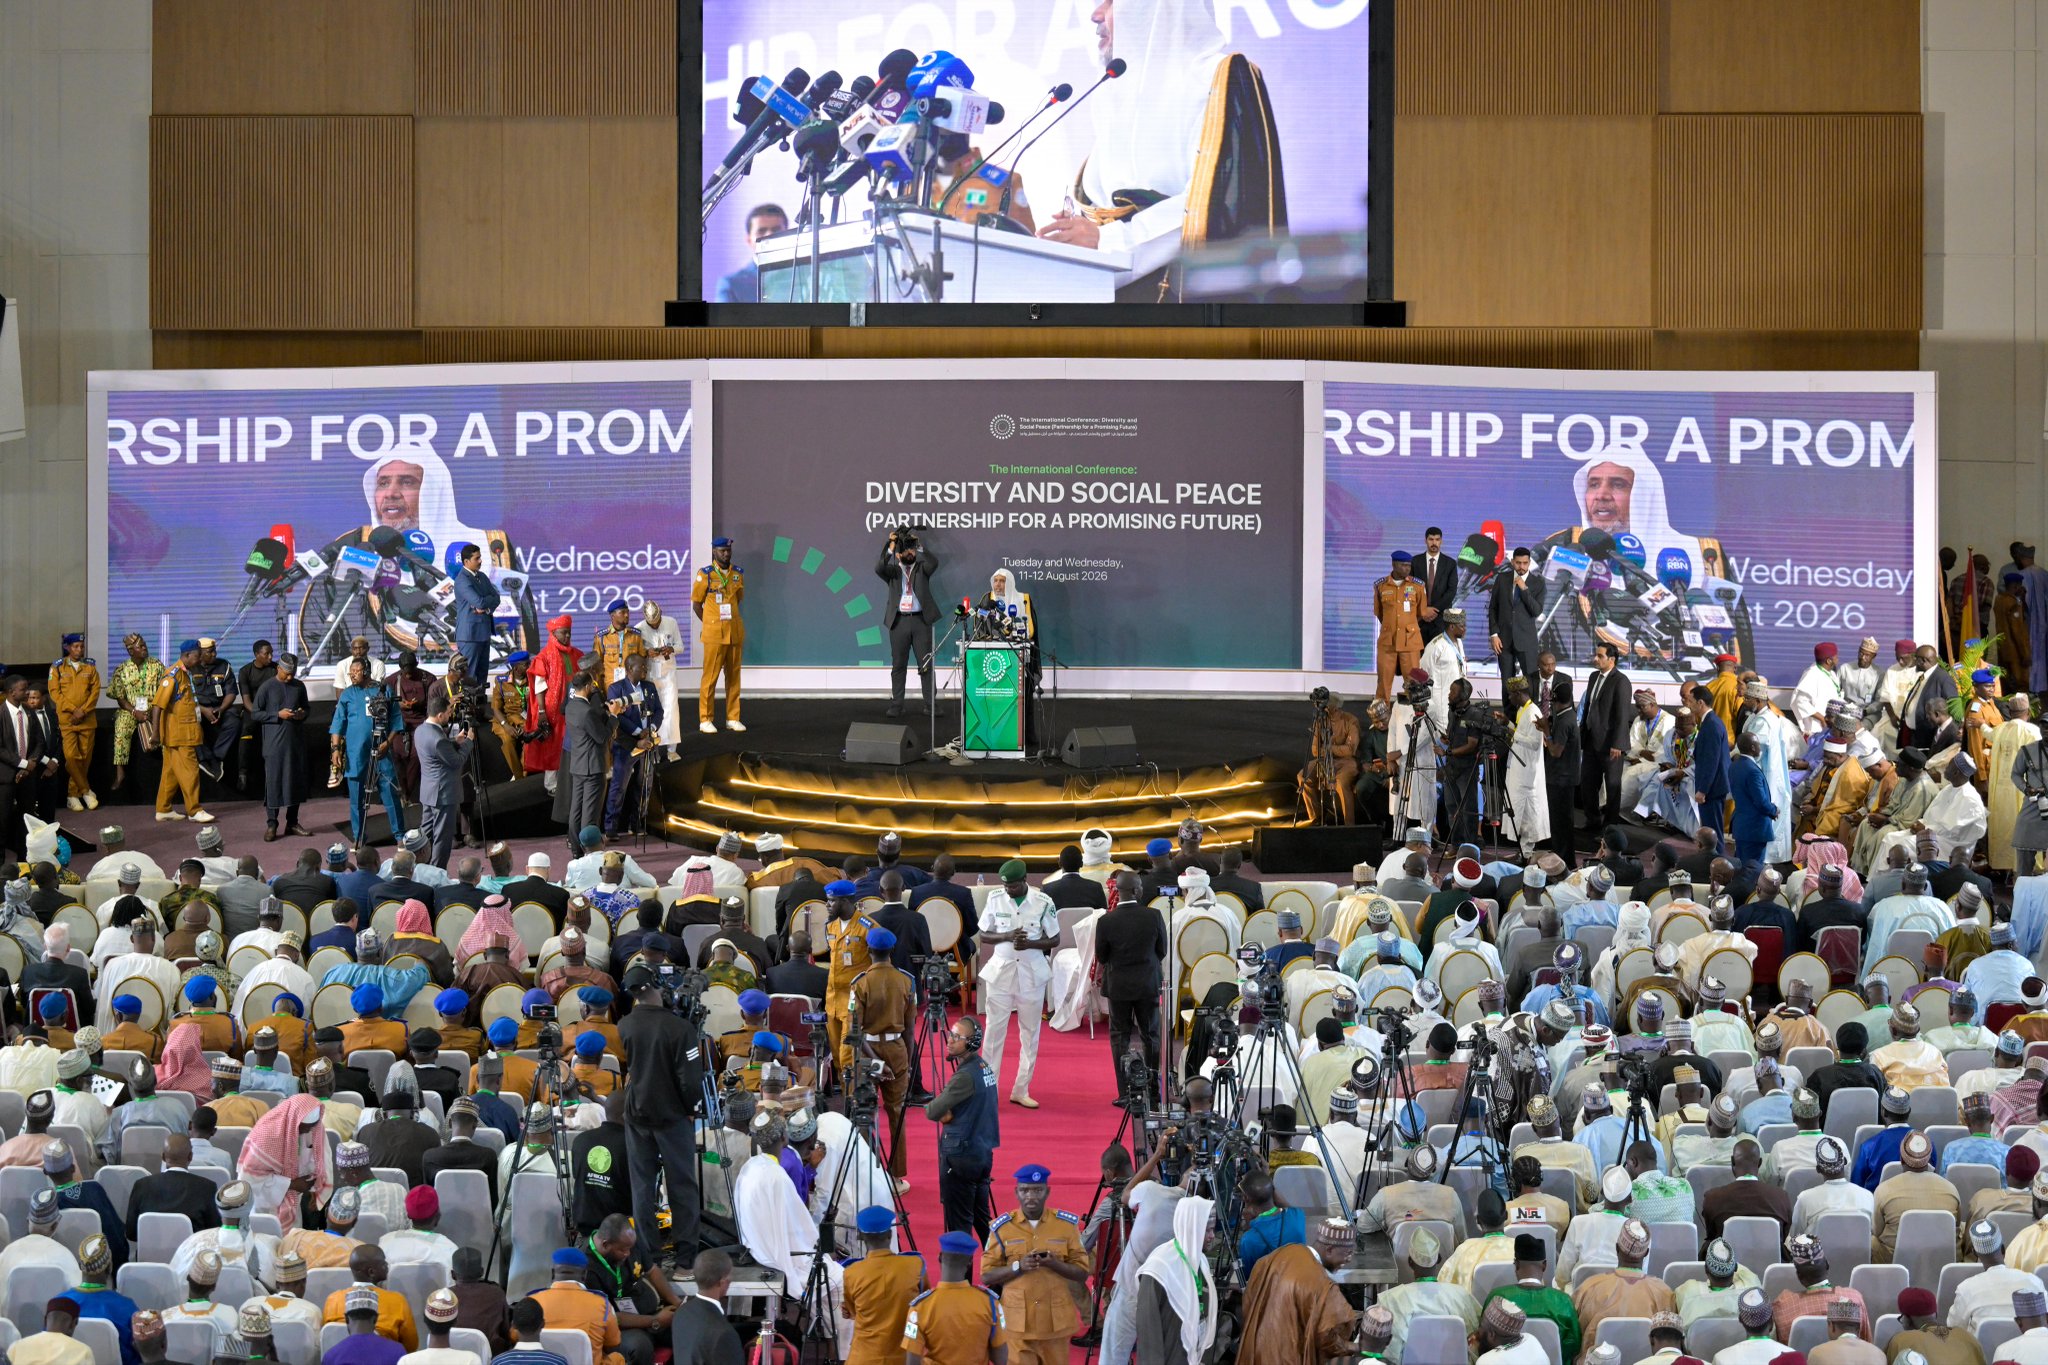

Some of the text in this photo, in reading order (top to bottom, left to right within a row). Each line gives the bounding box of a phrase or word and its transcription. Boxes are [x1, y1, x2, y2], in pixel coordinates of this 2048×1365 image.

[827, 100, 844, 109] NEWS
[830, 90, 852, 101] ARISE
[310, 413, 438, 461] FOR
[453, 412, 499, 457] A
[515, 408, 692, 456] PROM
[1521, 413, 1649, 461] FOR
[1665, 416, 1712, 463] A
[1729, 417, 1914, 468] PROM
[989, 463, 1137, 475] The International Conference:
[866, 481, 1262, 505] DIVERSITY AND SOCIAL PEACE
[865, 511, 1262, 535] (PARTNERSHIP FOR A PROMISING FUTURE)
[358, 554, 378, 565] NEWS
[516, 544, 690, 575] Wednesday
[1002, 557, 1124, 570] Tuesday and Wednesday,
[1568, 556, 1588, 565] NEWS
[1667, 560, 1689, 571] RBN
[1018, 571, 1108, 582] 11-12 August 2026
[1729, 556, 1913, 595] Wednesday
[558, 585, 645, 613] 2026
[1774, 600, 1866, 631] 2026
